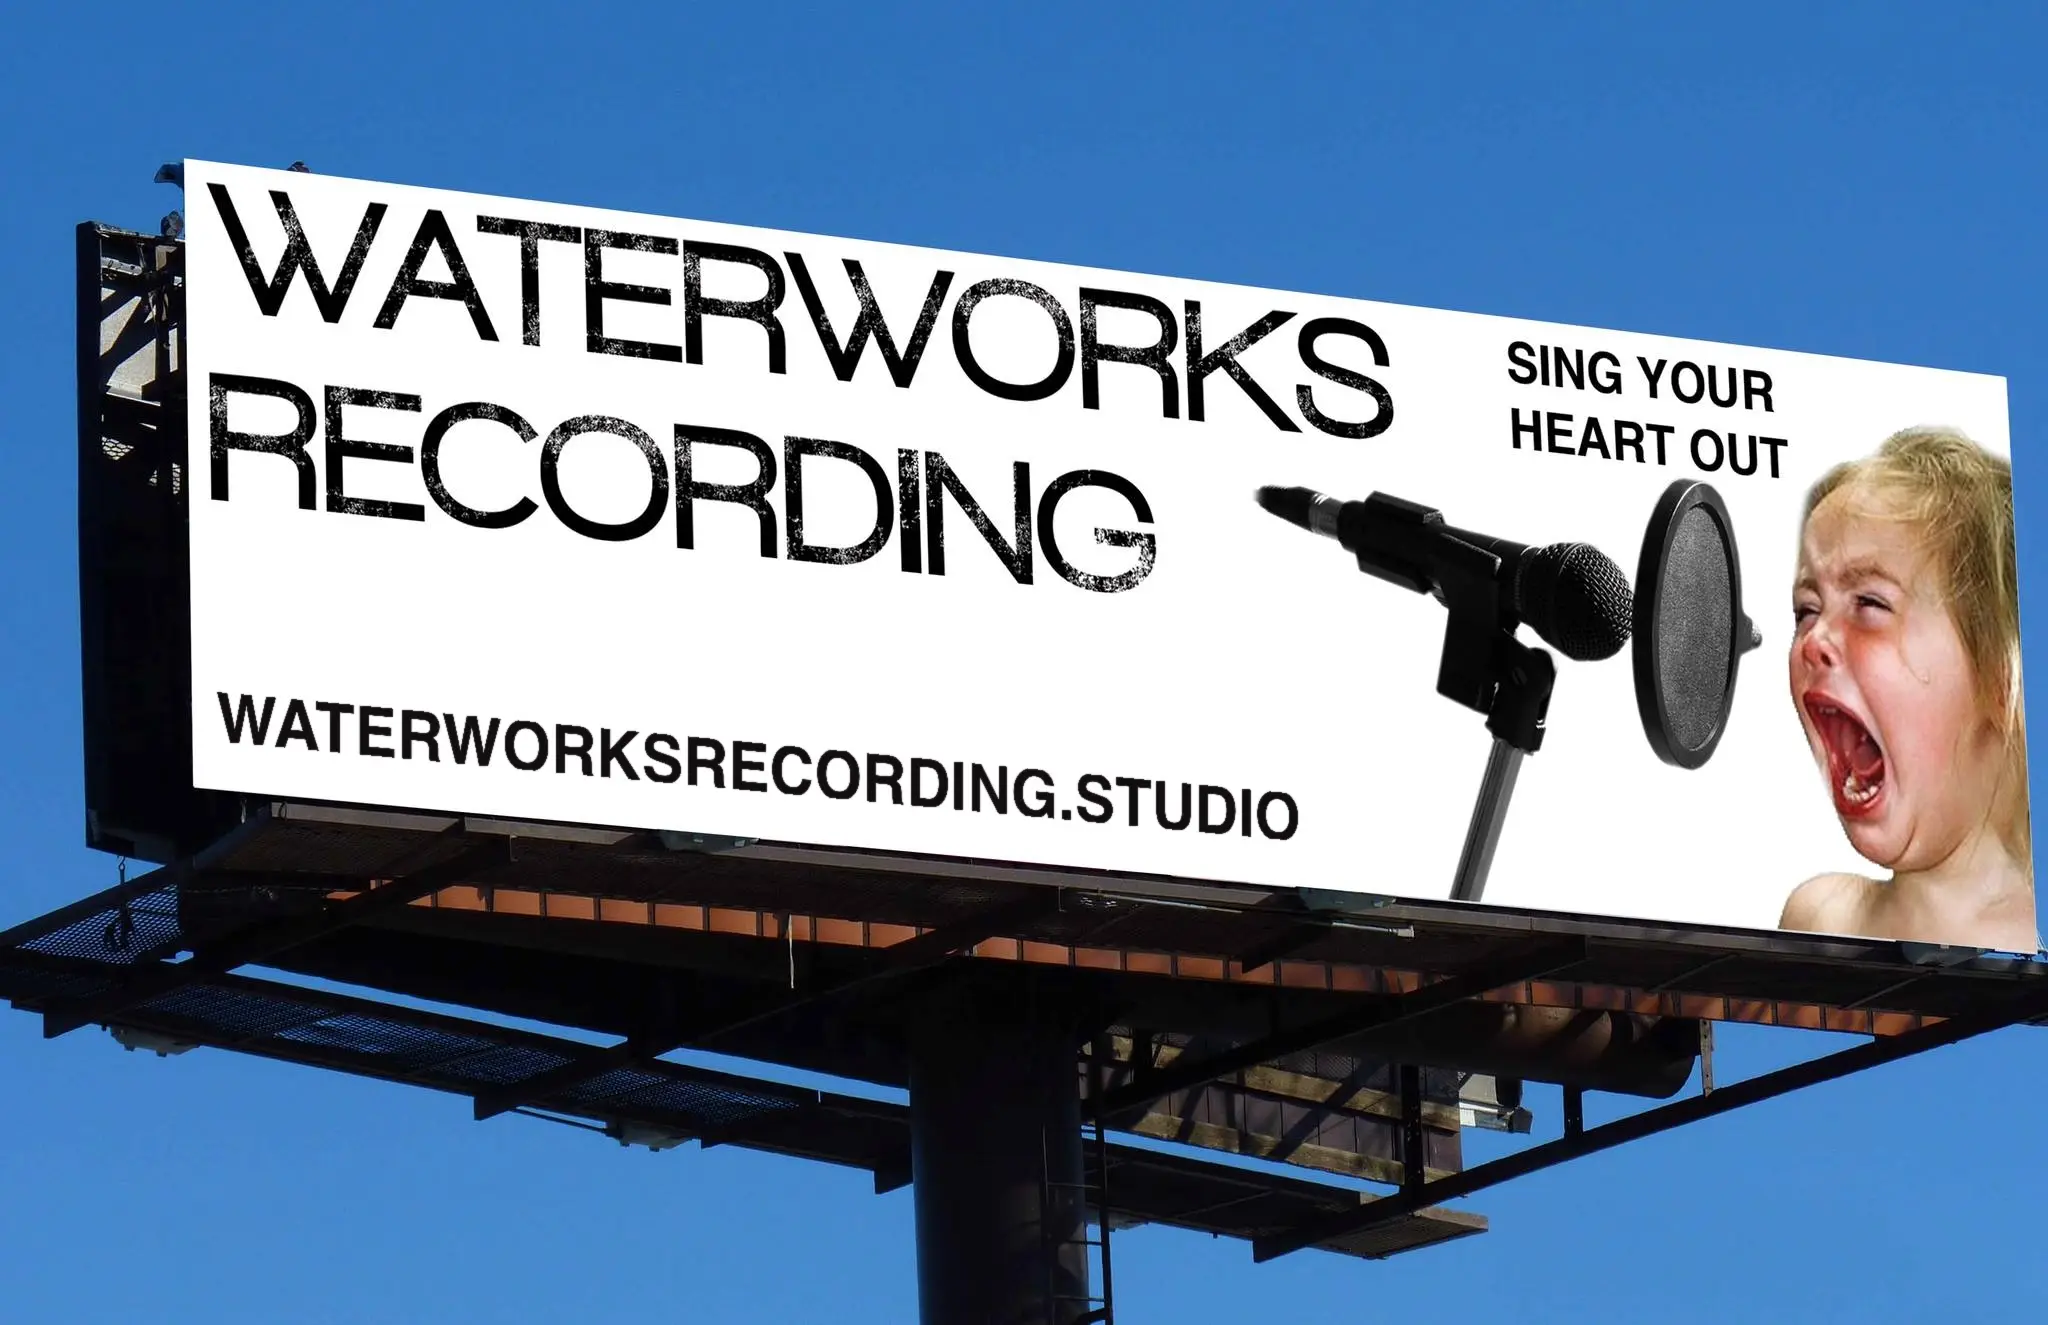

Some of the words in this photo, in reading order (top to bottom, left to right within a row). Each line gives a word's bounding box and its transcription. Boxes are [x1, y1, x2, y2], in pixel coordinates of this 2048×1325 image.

[206, 182, 1394, 440] WATERWORKS
[1507, 340, 1623, 395] SING
[1636, 356, 1775, 413] YOUR
[208, 371, 1157, 594] RECORDING
[1511, 407, 1676, 467] HEART
[1690, 428, 1789, 480] OUT
[216, 691, 1299, 841] WATERWORKSRECORDING.STUDIO
